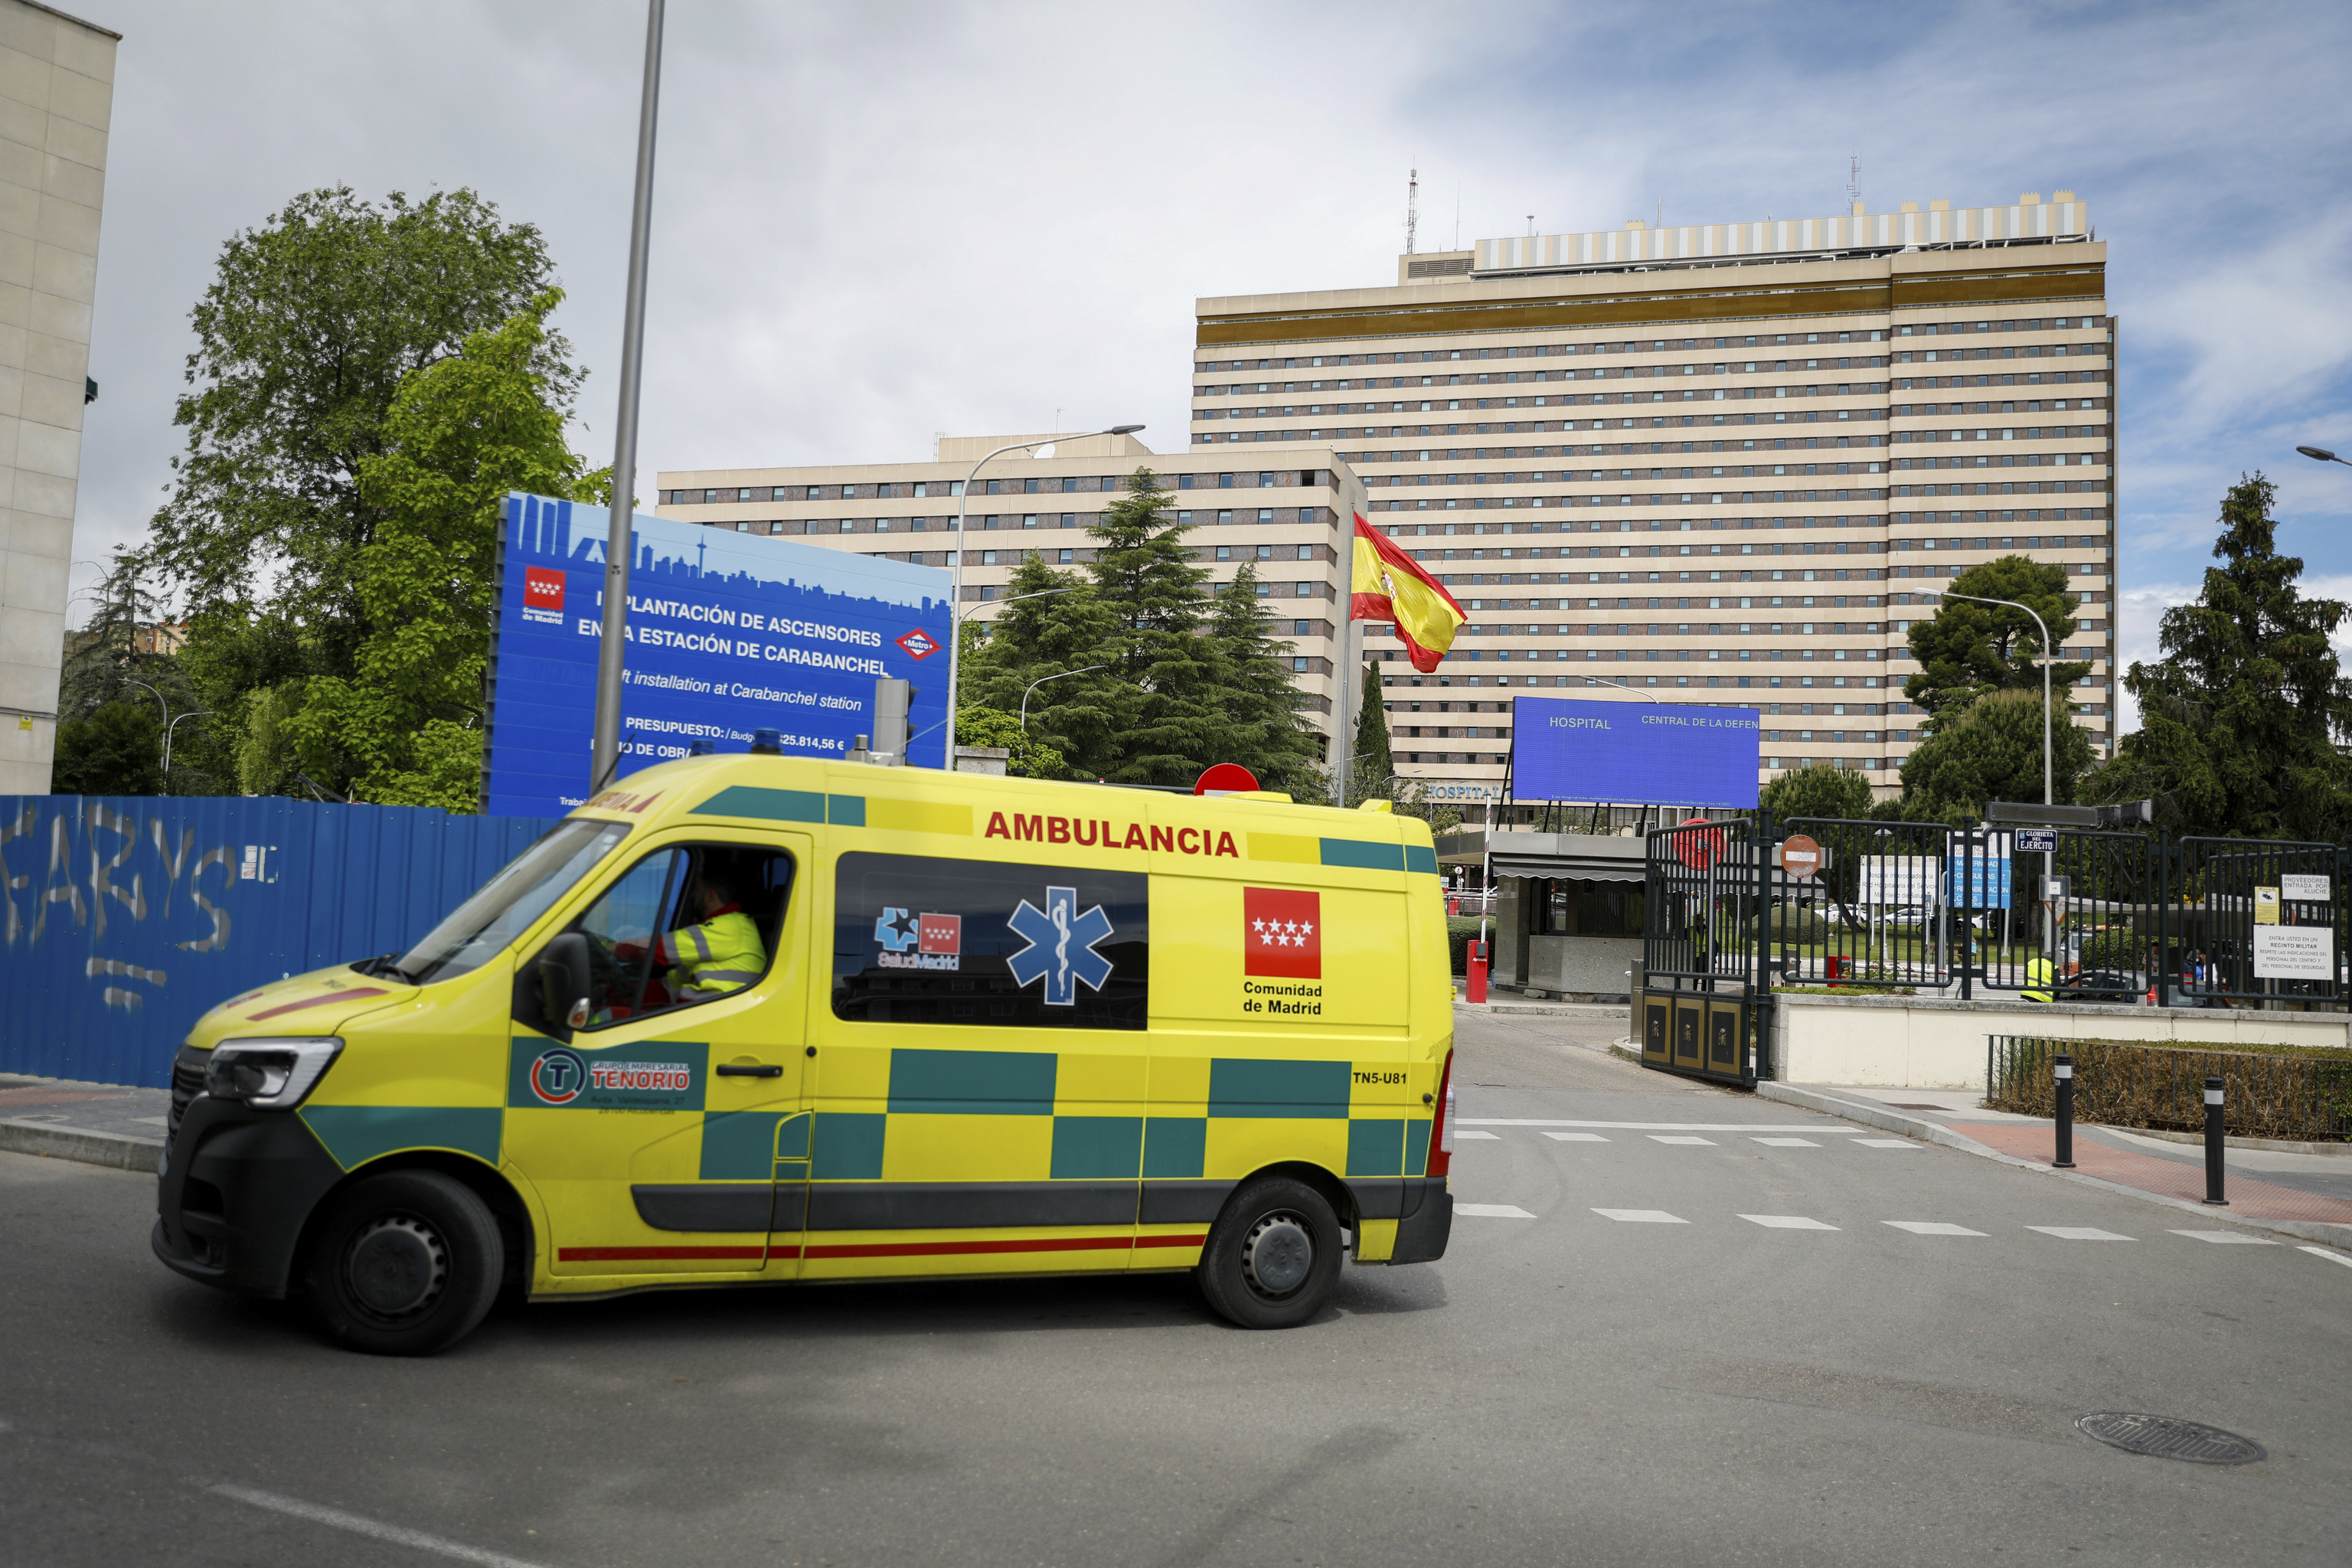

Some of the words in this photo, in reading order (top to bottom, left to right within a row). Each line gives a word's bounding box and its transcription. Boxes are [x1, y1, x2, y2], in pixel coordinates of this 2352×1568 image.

[523, 606, 564, 619] Comunidad
[534, 615, 563, 625] Madrid
[596, 591, 735, 626] ILANTACIÓN
[740, 612, 764, 630] DE
[768, 617, 881, 648] ASCENSORES
[639, 627, 731, 655] ESTACIÓN
[737, 642, 760, 658] DE
[764, 645, 889, 676] CARABANCHEL
[906, 639, 929, 650] Metro
[634, 671, 710, 694] installation
[714, 683, 728, 696] at
[731, 683, 818, 706] Carabanchel
[819, 695, 862, 711] station
[626, 717, 724, 738] PRESUPUESTO:
[1550, 717, 1612, 730] HOSPITAL
[1642, 715, 1690, 727] CENTRAL
[1692, 717, 1706, 727] DE
[1709, 718, 1722, 727] LA
[1725, 720, 1759, 729] DEFEN
[636, 743, 655, 756] DE
[1424, 786, 1501, 799] HOSPITAL
[985, 812, 1240, 858] AMBULANCIA
[2020, 841, 2053, 851] EJERCITO
[1243, 982, 1321, 997] Comunidad
[1243, 999, 1263, 1012] de
[1268, 1000, 1321, 1015] Madrid
[591, 1062, 624, 1070] GRUPO
[626, 1063, 690, 1072] EMPRESARIAL
[591, 1070, 690, 1090] TENORIO
[1353, 1072, 1406, 1084] TN5-U81
